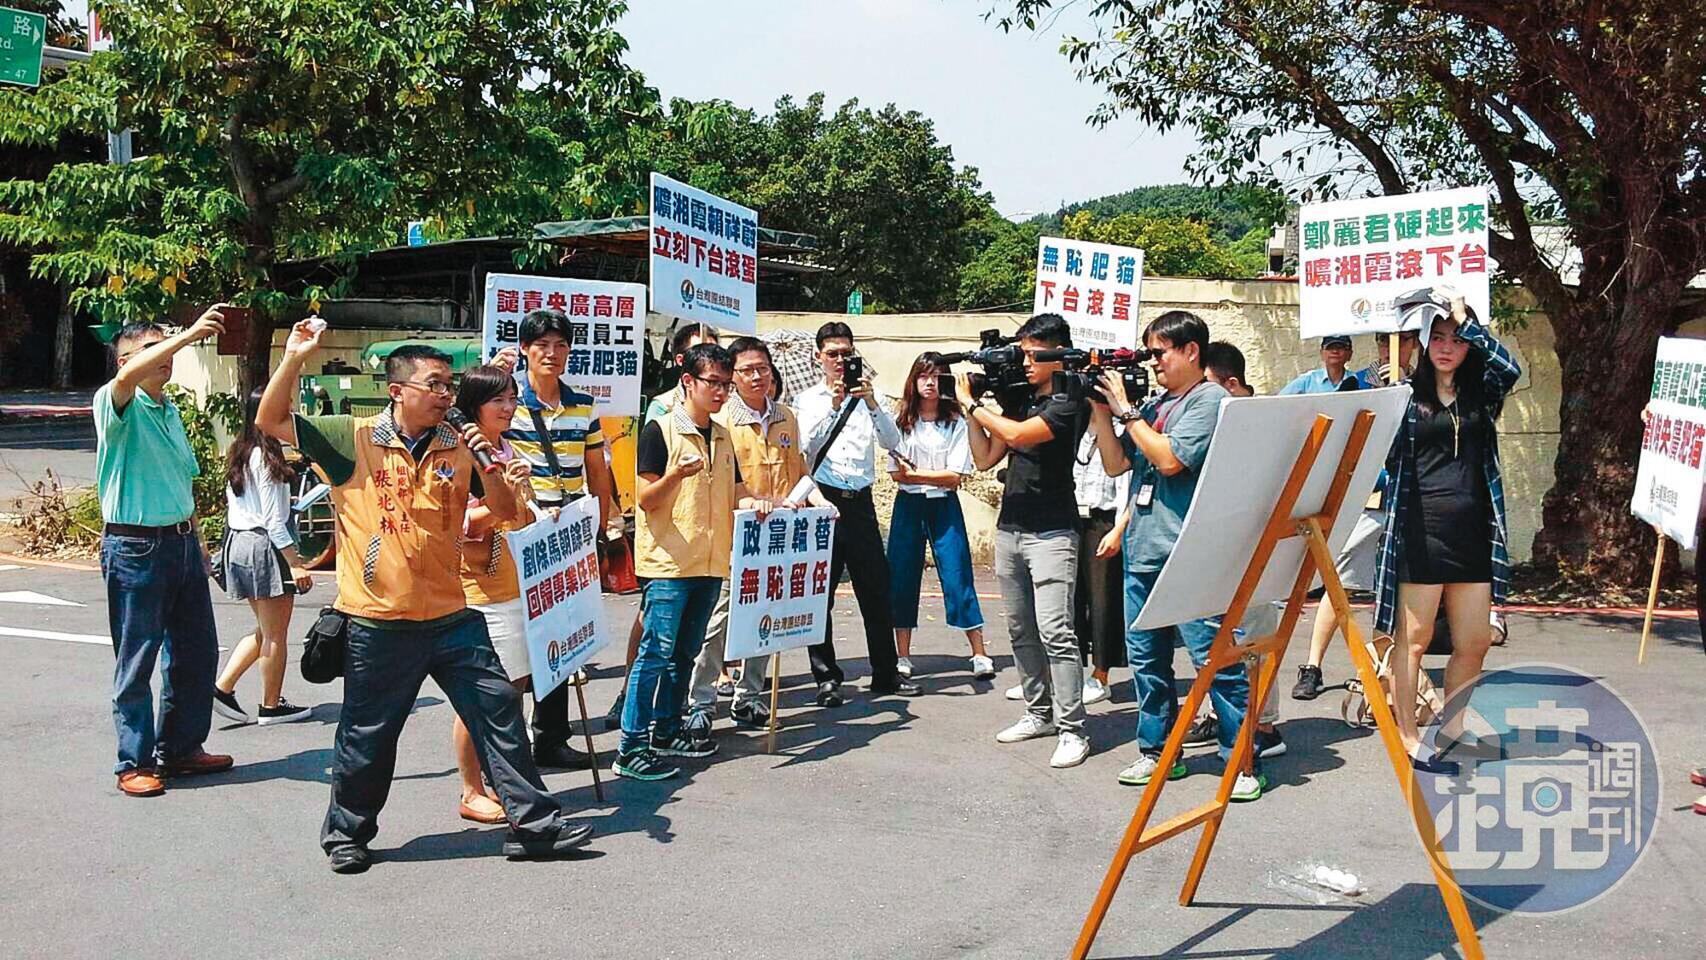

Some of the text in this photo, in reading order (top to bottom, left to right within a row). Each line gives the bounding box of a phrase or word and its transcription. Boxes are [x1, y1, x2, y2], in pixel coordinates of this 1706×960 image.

[13, 15, 32, 36] 路
[15, 69, 27, 79] 47
[1303, 203, 1487, 250] 鄭麗君硬起來
[653, 226, 756, 285] 立刻下台滾蛋
[496, 289, 635, 318] 譴責央廣高層
[1040, 280, 1131, 320] 下台滾蛋
[495, 320, 634, 346] 迫層員工
[742, 515, 831, 557] 政黨輪替
[525, 551, 600, 621] 回歸專業任用
[739, 560, 828, 606] 無恥留任
